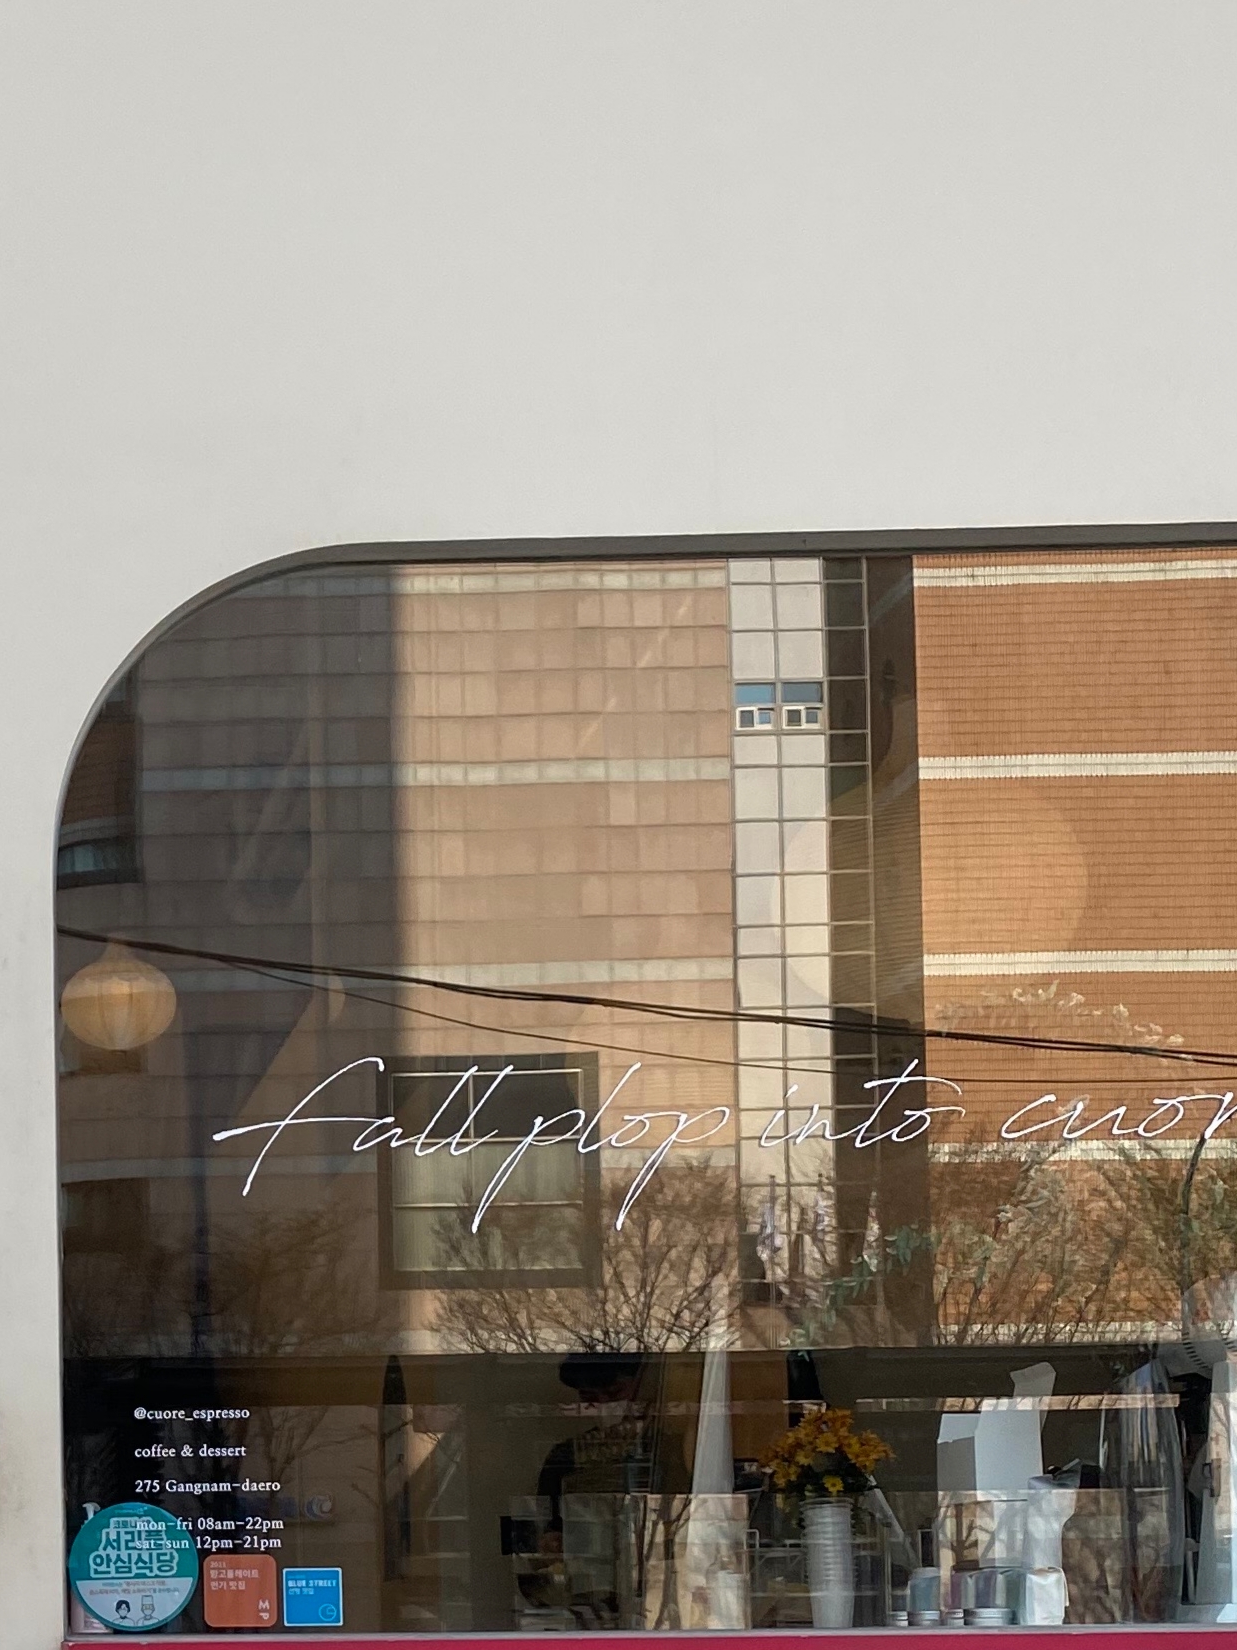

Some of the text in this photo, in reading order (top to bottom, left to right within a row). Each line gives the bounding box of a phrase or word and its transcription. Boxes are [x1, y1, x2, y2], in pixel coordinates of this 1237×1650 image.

[213, 1057, 514, 1196] fall
[471, 1062, 731, 1233] plop
[760, 1059, 966, 1148] into
[133, 1406, 250, 1422] @cuore_espresso
[134, 1443, 247, 1458] coffee & dessert
[134, 1478, 281, 1495] 275 Gangnam-daero
[135, 1516, 284, 1533] mon-fri 08am-22pm
[134, 1535, 282, 1551] sat-sun 12pm-21pm
[91, 1551, 176, 1575] 안심식당
